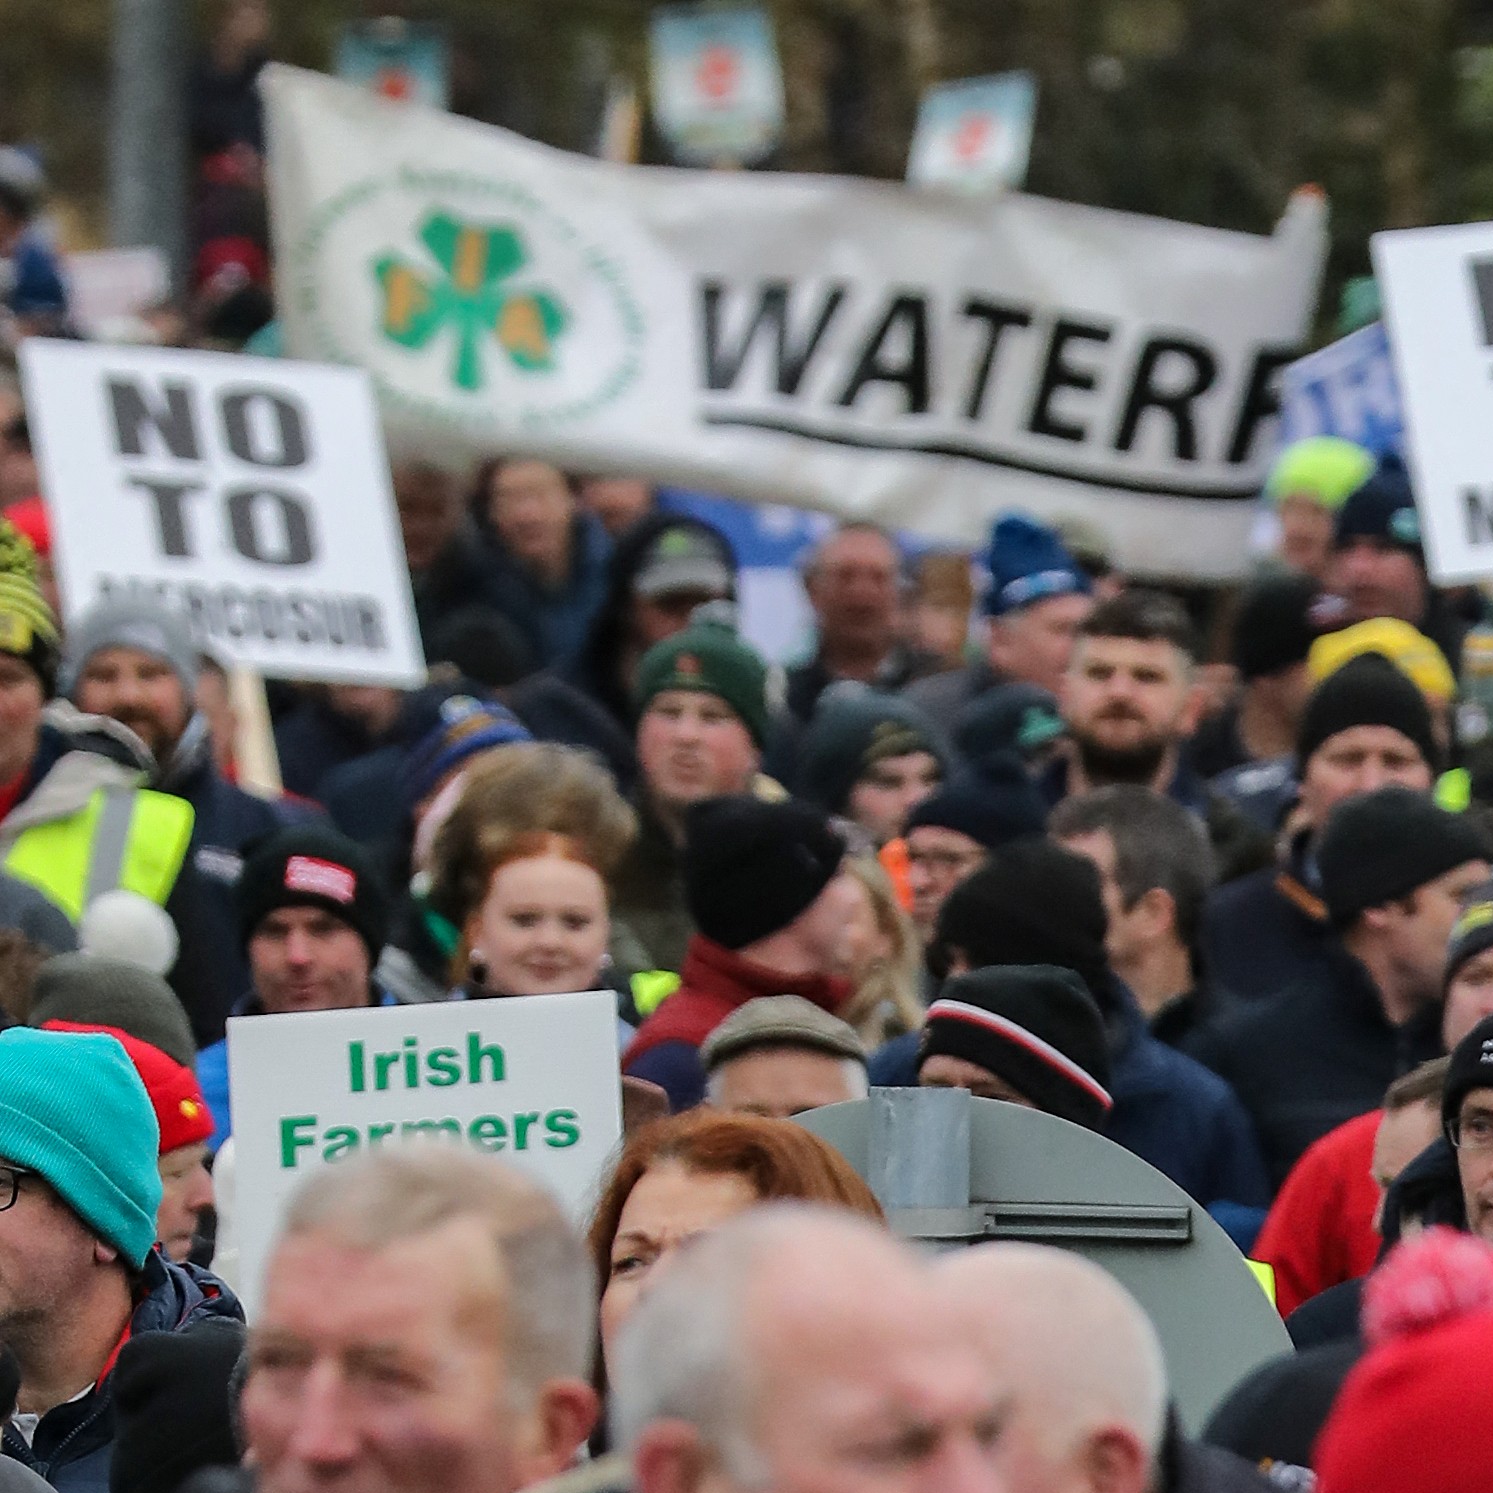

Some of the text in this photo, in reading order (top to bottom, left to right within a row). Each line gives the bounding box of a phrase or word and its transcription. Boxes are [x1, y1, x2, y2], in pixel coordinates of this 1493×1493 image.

[702, 282, 1297, 467] WATERF
[106, 379, 309, 469] NO
[129, 478, 316, 568] TO
[348, 1031, 506, 1092] Irish
